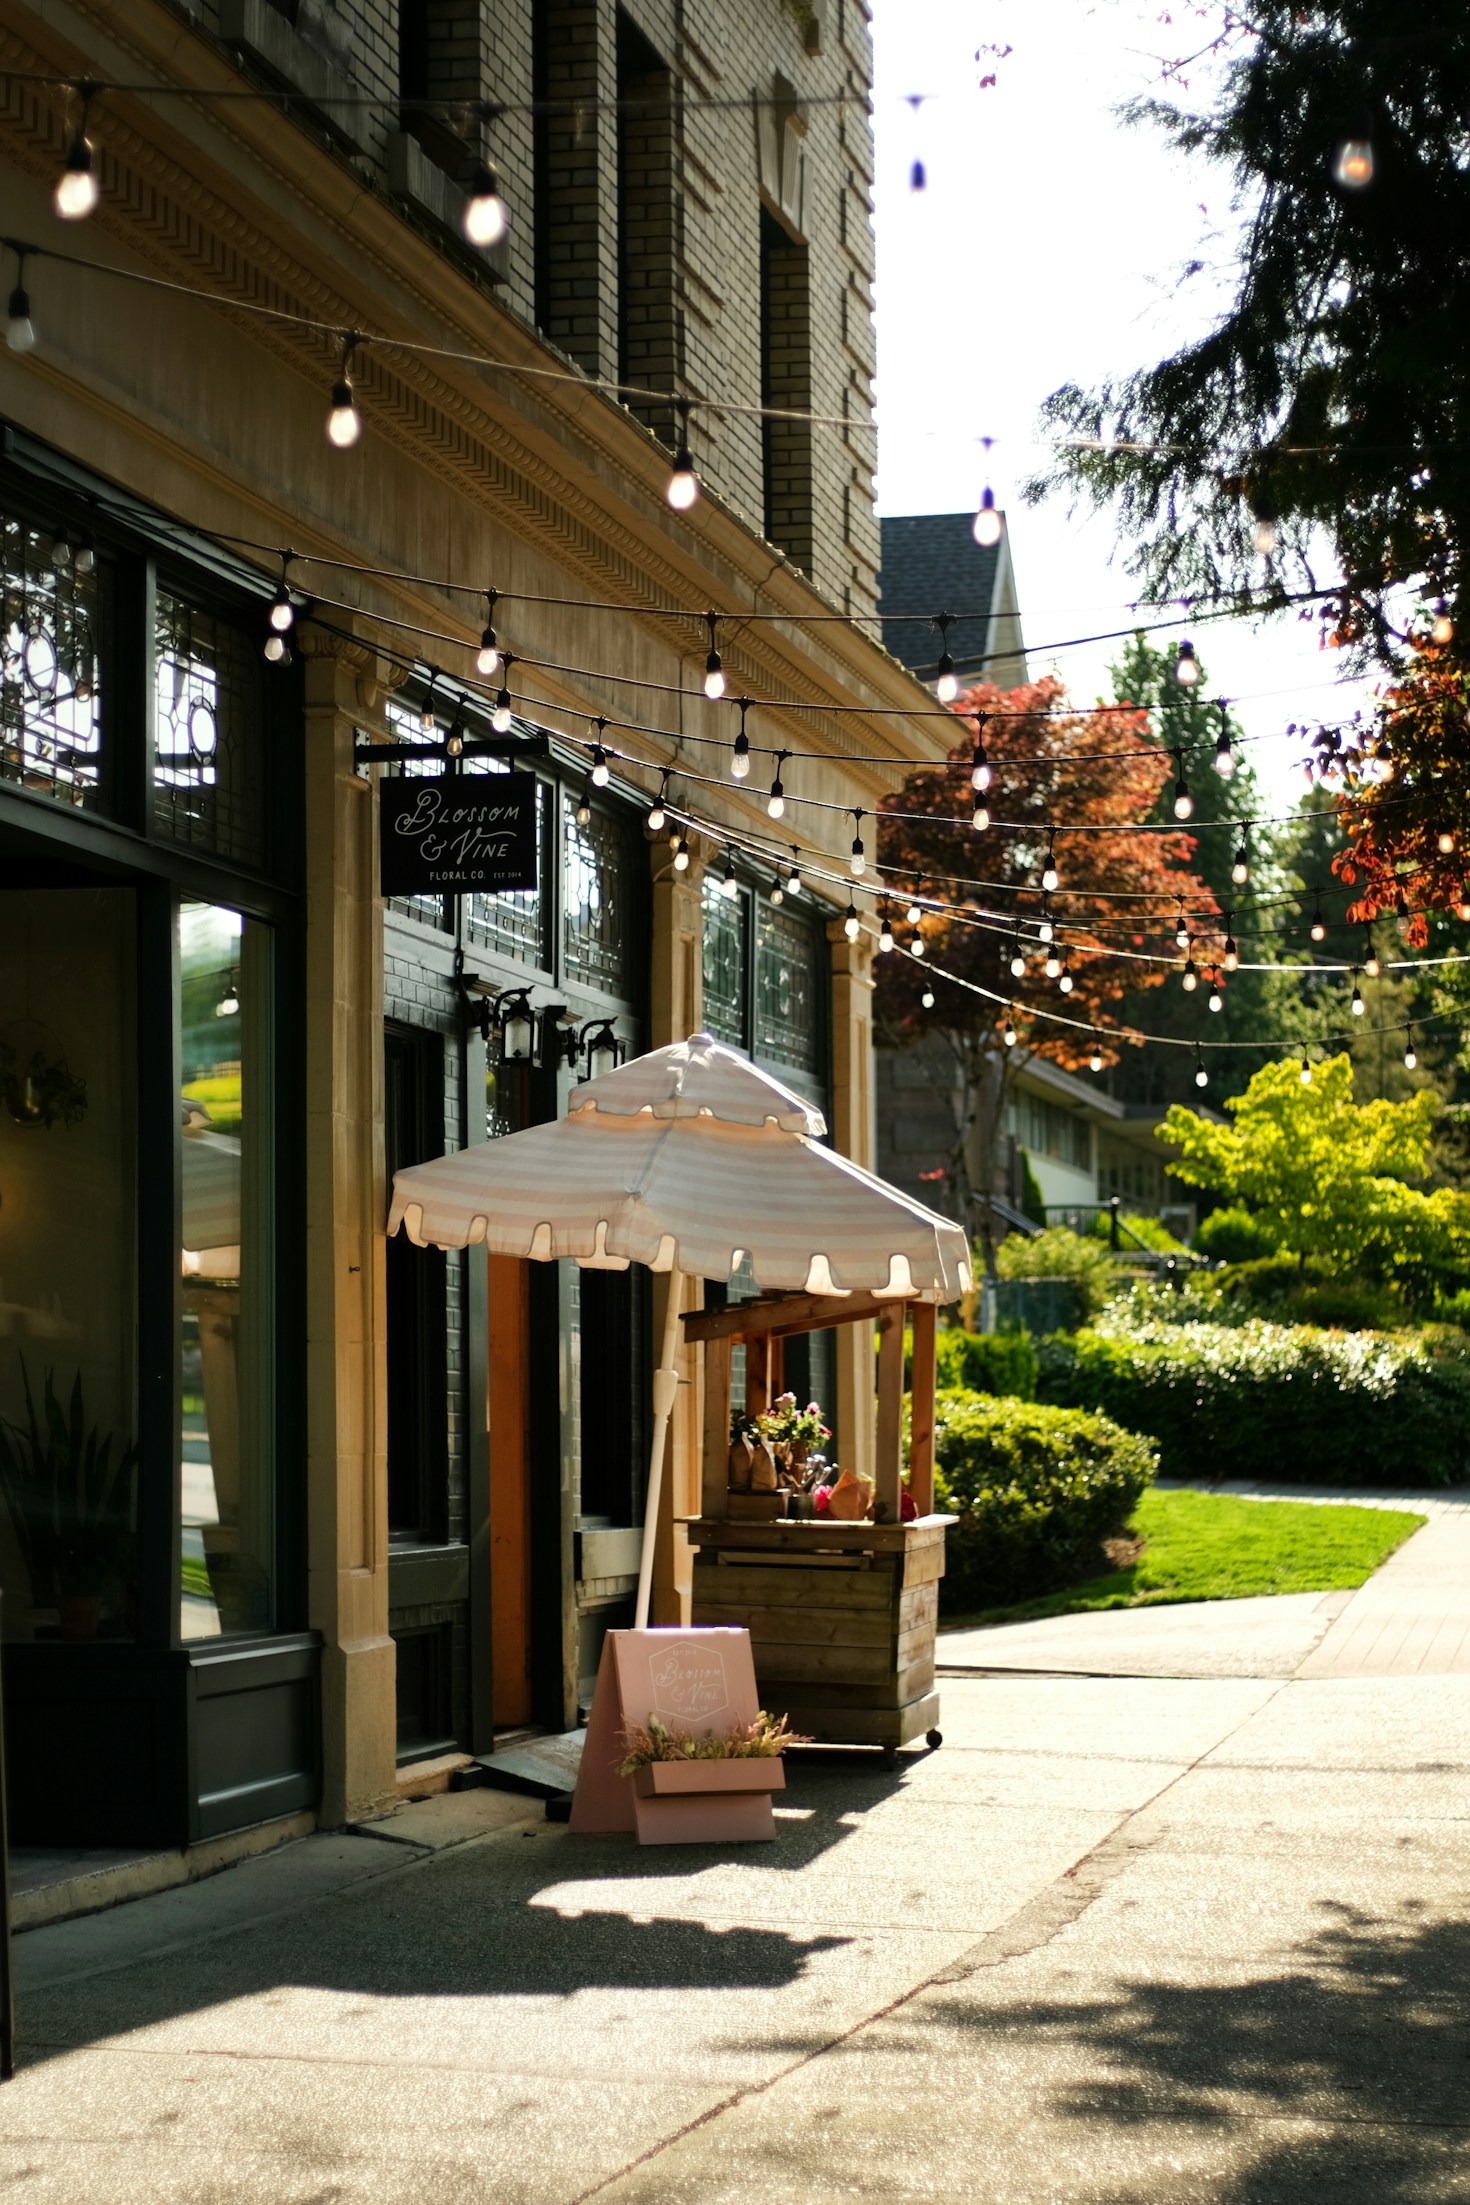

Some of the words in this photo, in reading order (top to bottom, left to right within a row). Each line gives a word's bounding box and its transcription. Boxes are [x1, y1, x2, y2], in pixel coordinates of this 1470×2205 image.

[420, 833, 448, 862] &
[429, 871, 468, 881] FLORAL
[470, 870, 486, 880] CO.
